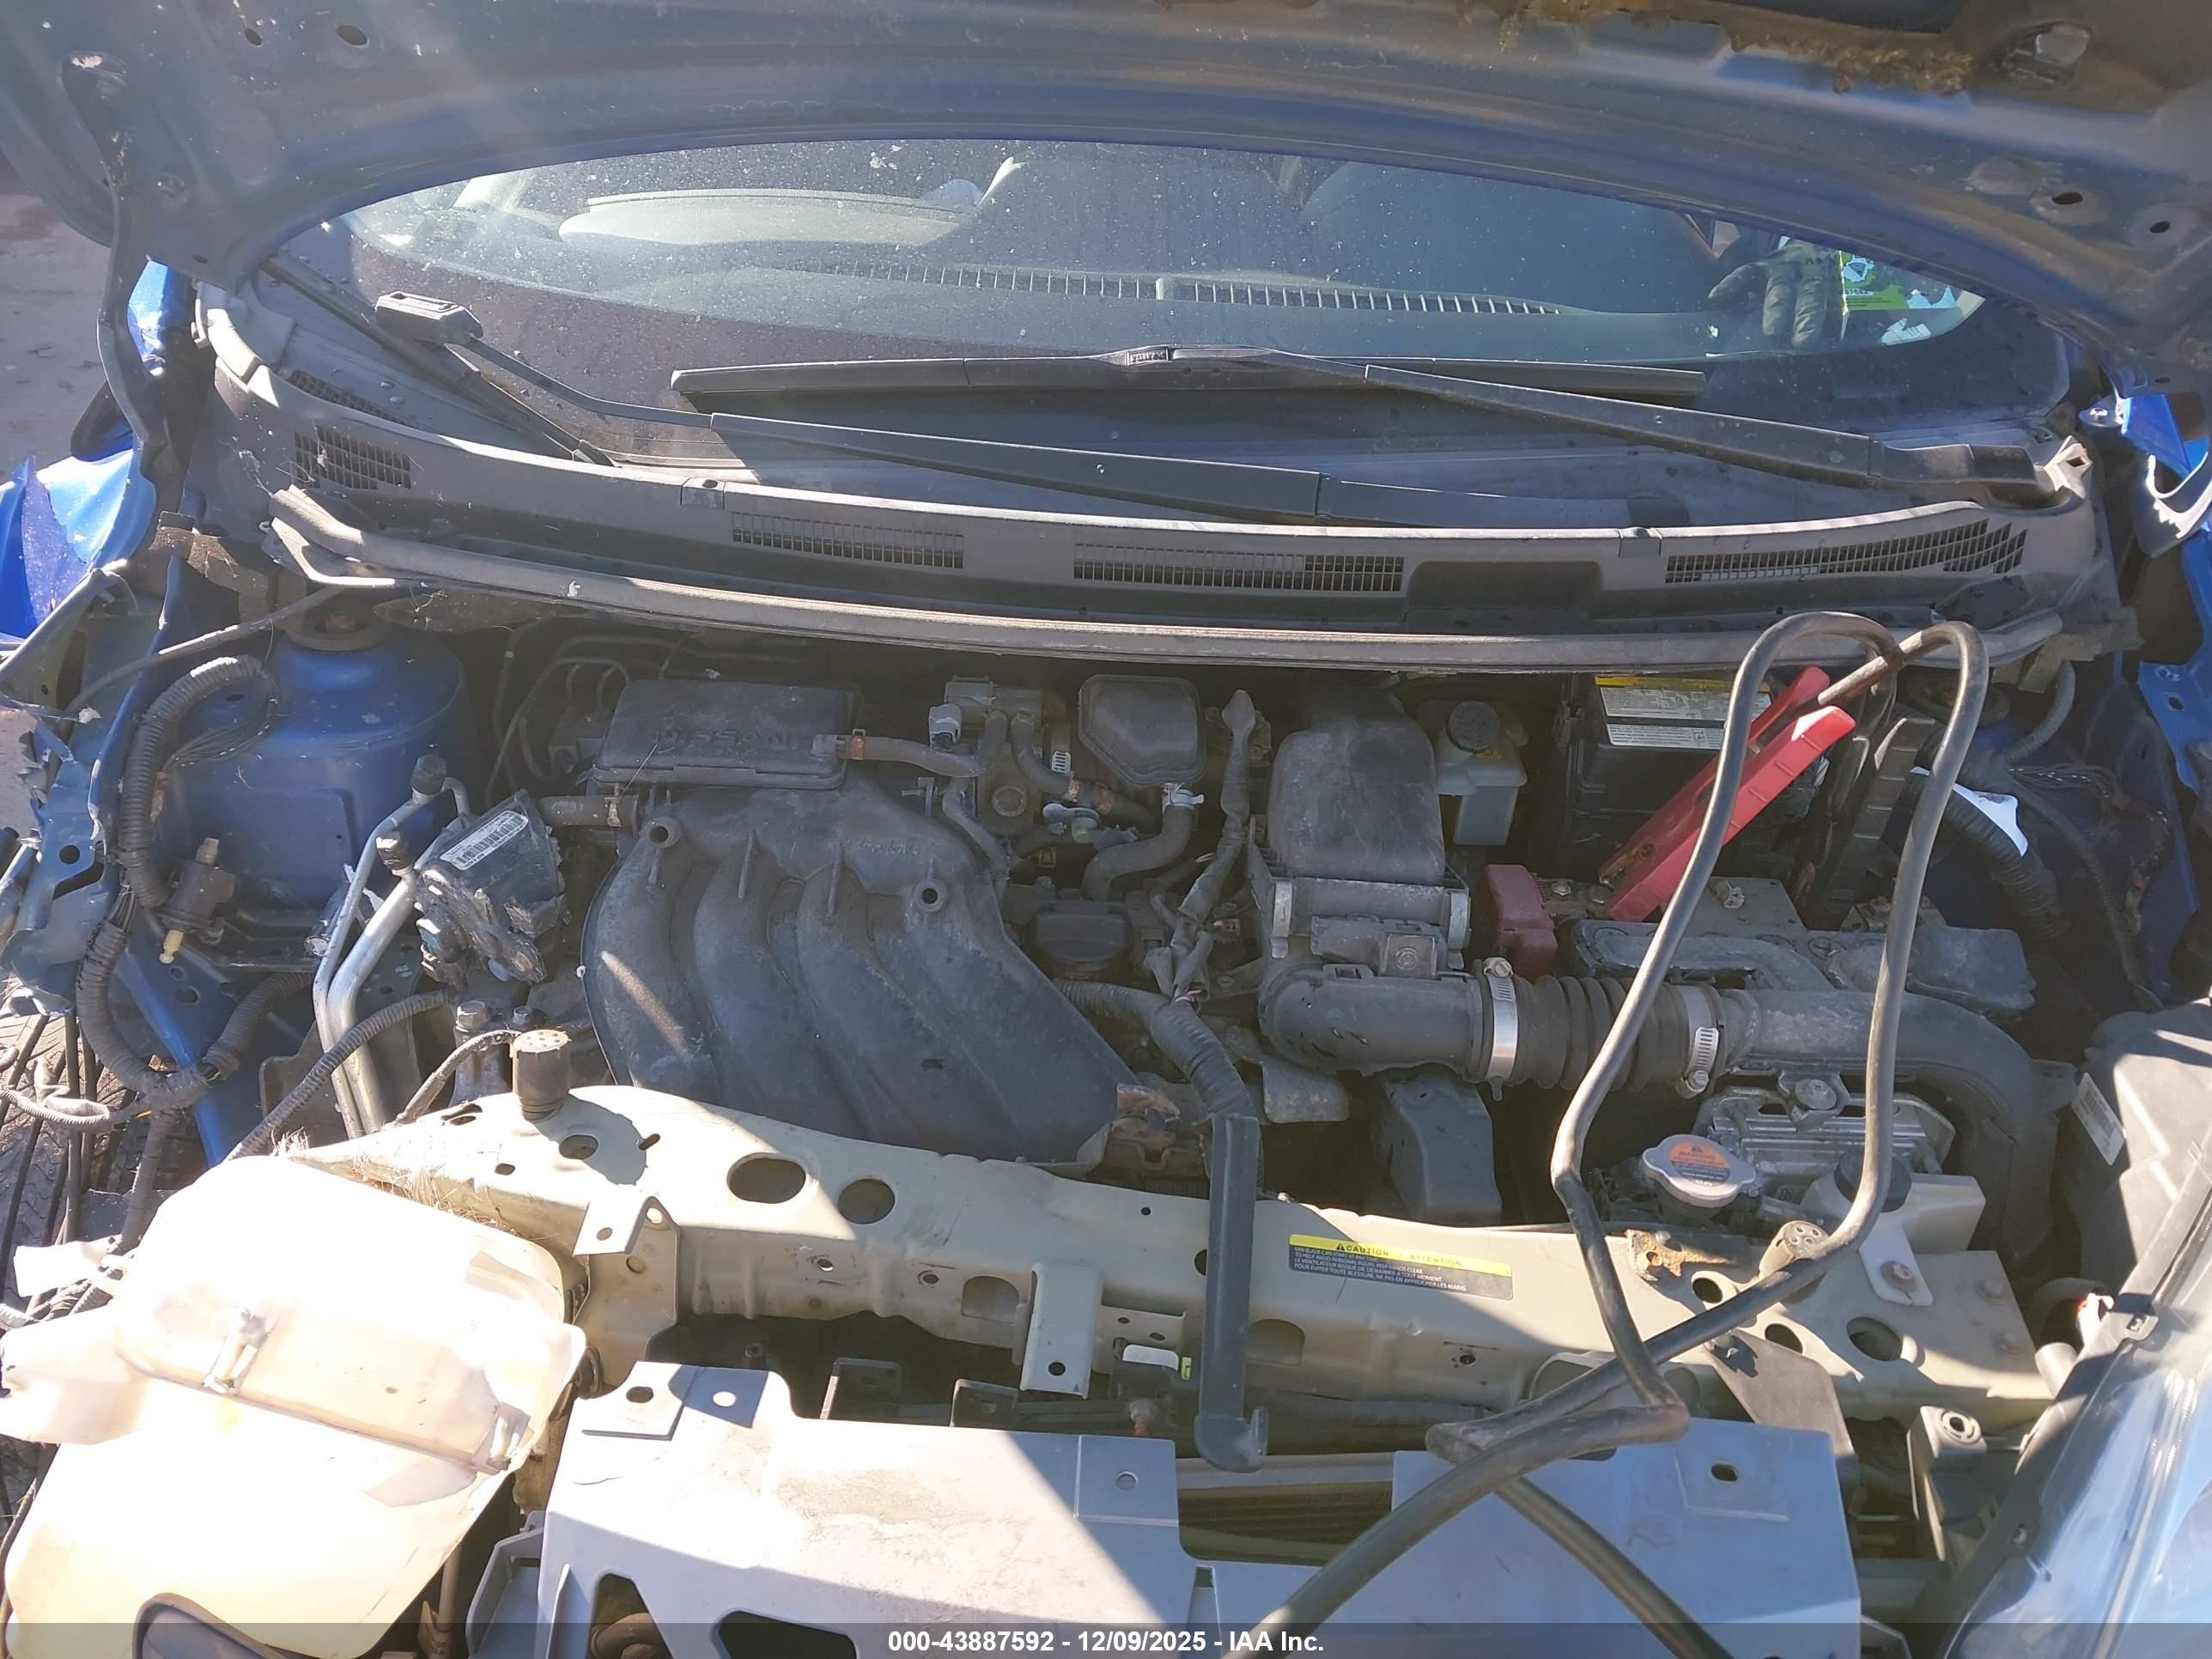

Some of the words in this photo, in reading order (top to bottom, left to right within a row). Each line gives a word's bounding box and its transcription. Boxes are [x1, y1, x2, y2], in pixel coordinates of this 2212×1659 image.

[1346, 1244, 1389, 1256] CAUTION
[1302, 1258, 1336, 1267] VENTILATEUR
[1410, 1254, 1462, 1266] ATTENTION
[1403, 1277, 1436, 1286] APPROCHER
